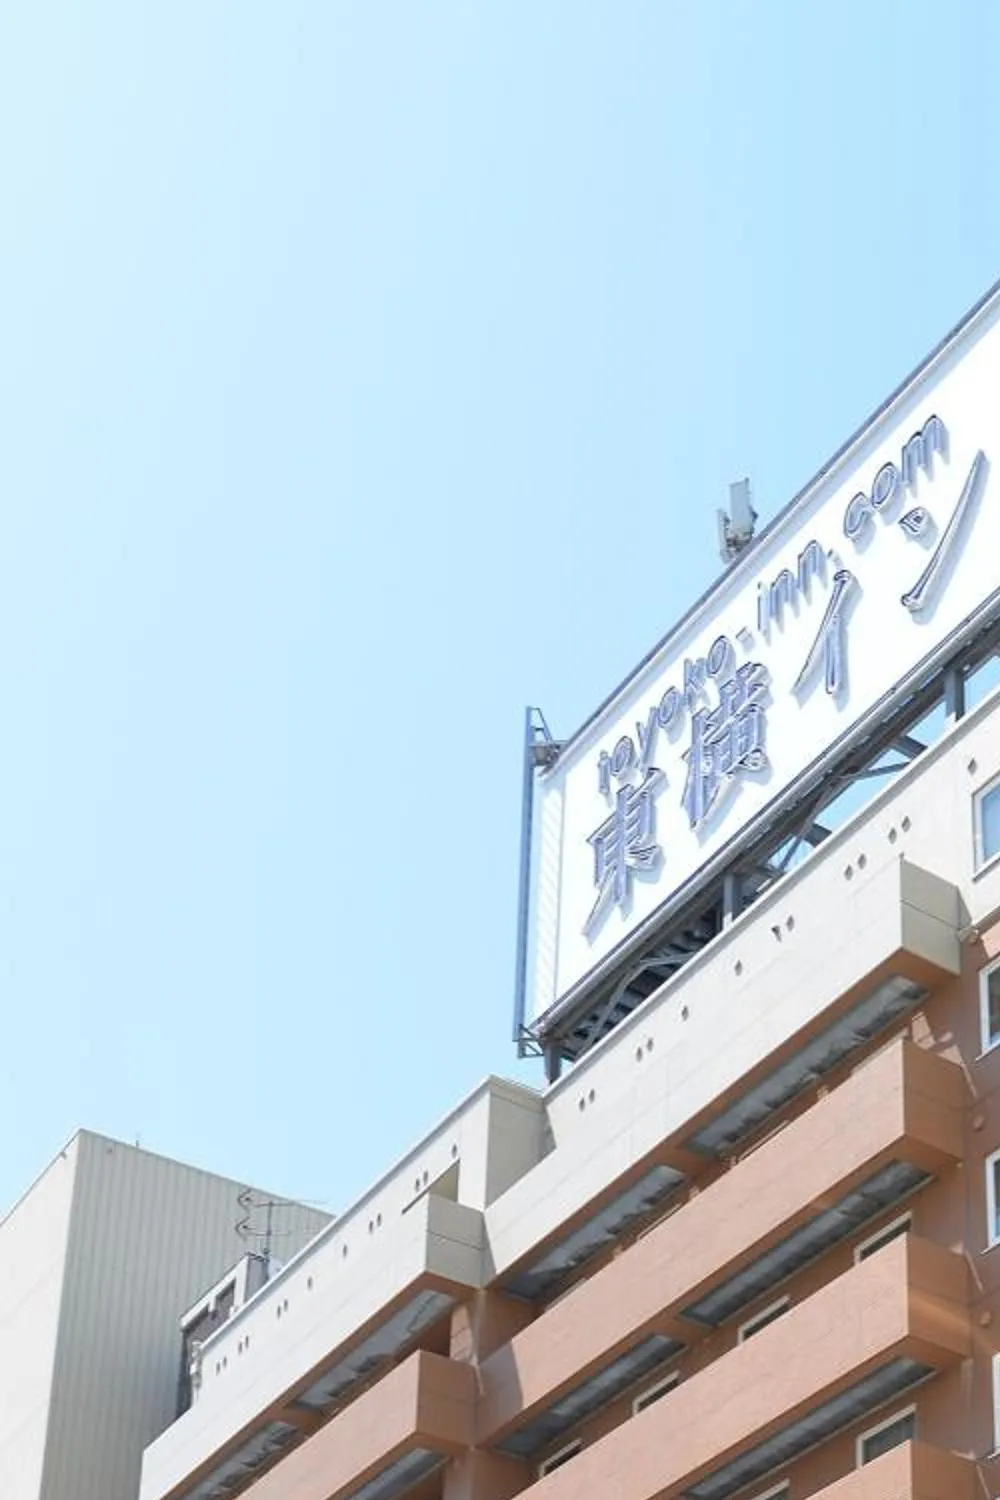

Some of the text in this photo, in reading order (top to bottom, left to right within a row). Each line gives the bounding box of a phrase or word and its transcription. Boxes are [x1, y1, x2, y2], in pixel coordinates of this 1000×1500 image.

[582, 449, 989, 942] 東横イン
[597, 414, 951, 798] toyoko-inn.com
